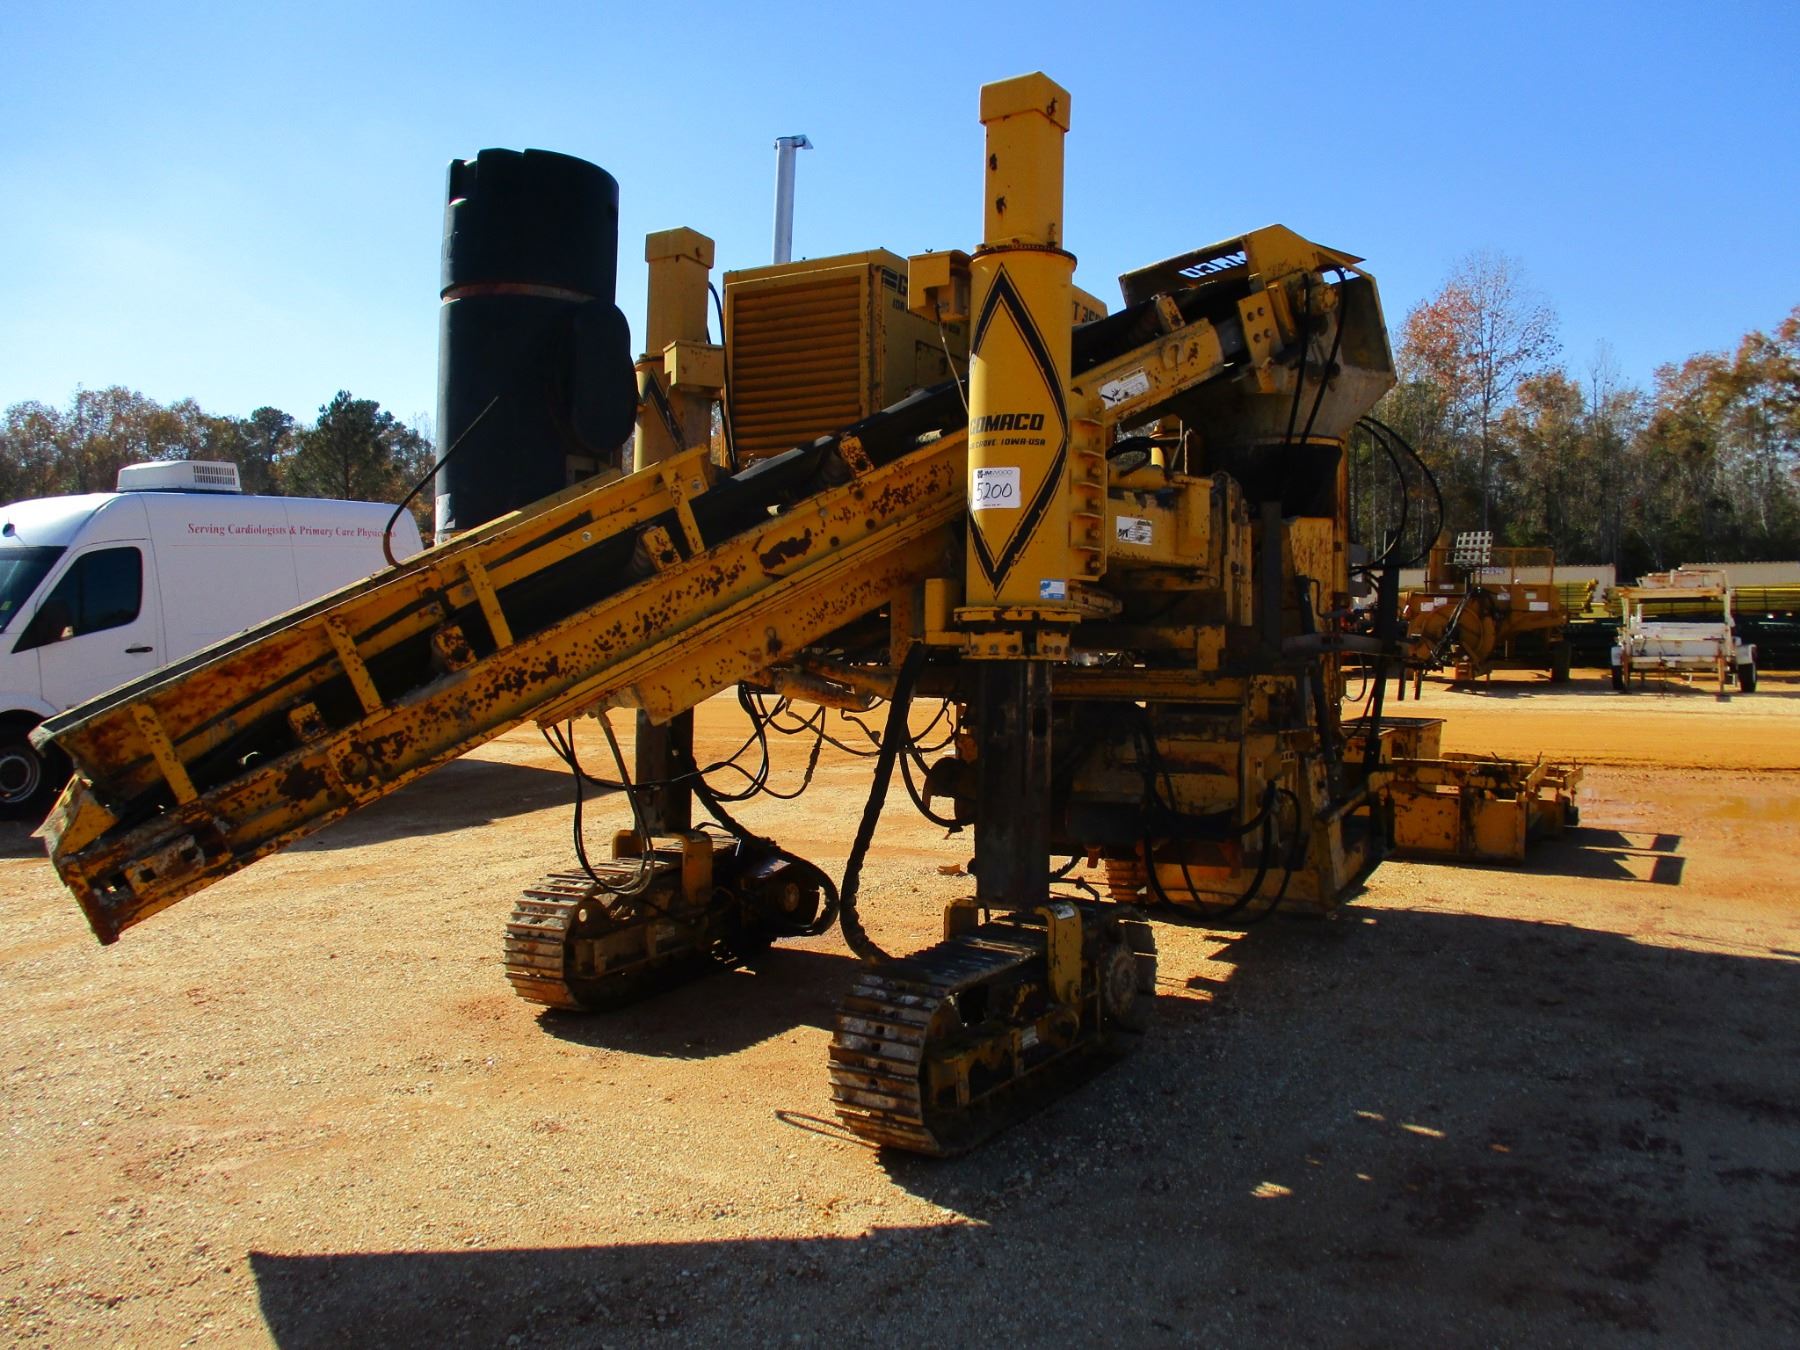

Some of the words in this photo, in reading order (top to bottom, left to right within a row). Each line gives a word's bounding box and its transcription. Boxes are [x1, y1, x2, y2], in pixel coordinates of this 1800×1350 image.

[976, 481, 1013, 502] 5200
[188, 523, 225, 536] Serving
[228, 523, 287, 536] Cardiologists
[289, 525, 297, 535] &
[300, 525, 333, 537] Primary
[335, 527, 354, 537] Care
[357, 527, 397, 538] Physicins
